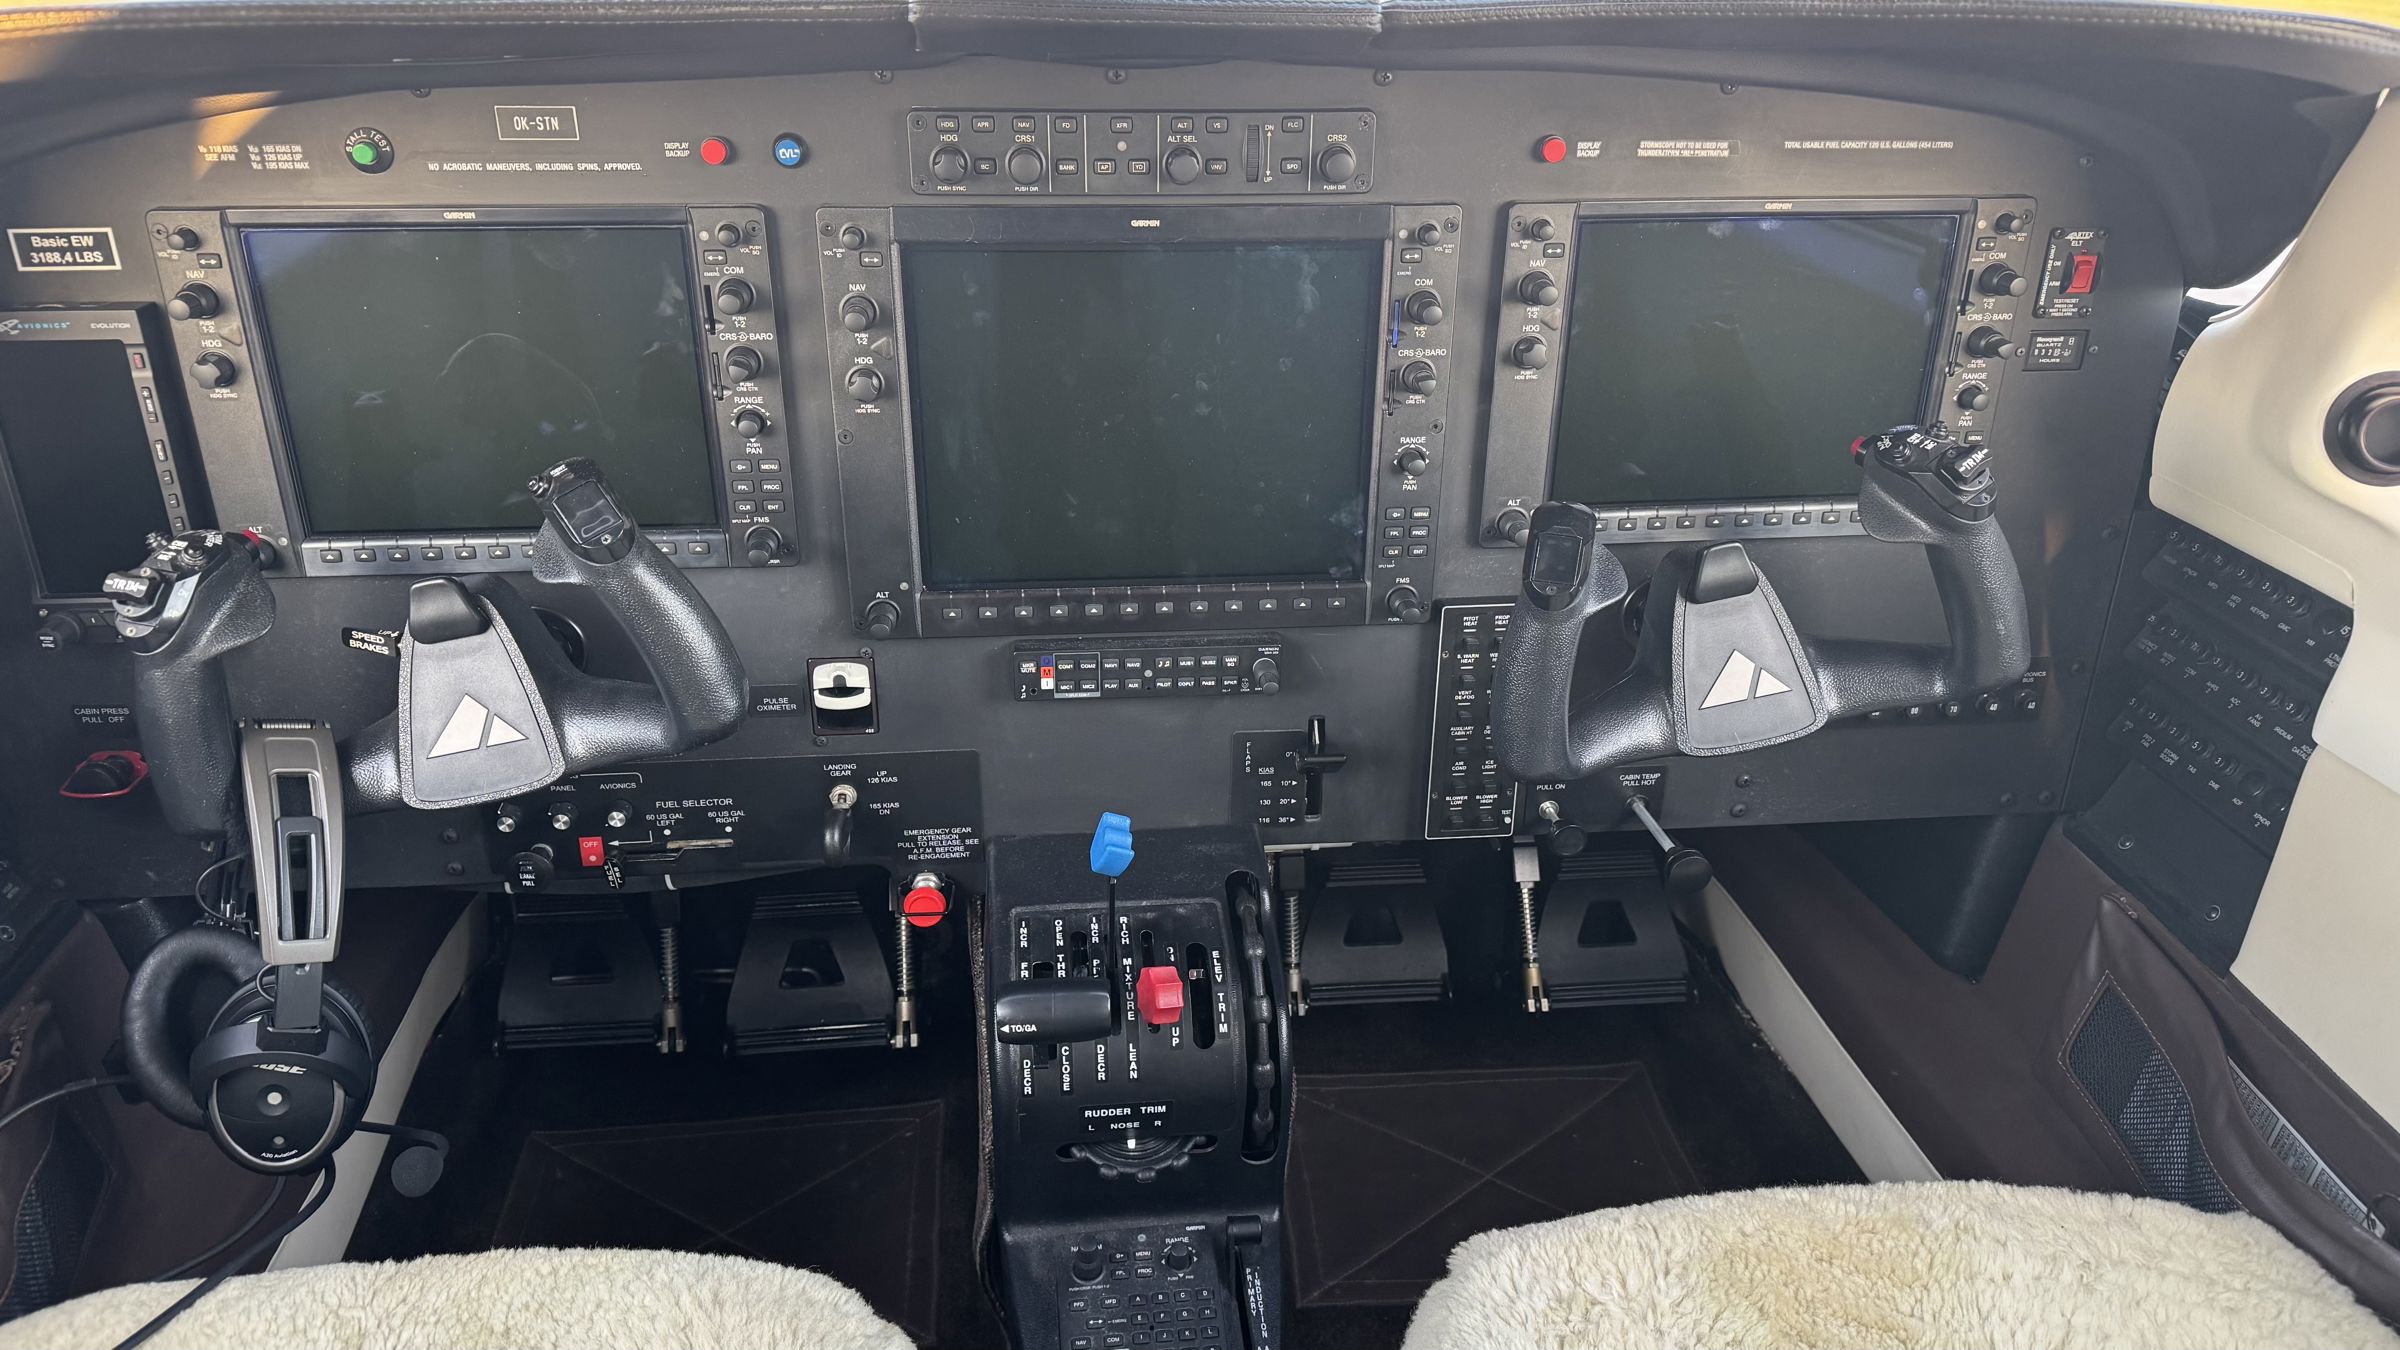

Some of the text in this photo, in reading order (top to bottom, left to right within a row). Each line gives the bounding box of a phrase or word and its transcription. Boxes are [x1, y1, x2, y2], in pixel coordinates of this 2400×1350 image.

[513, 116, 560, 131] OK-STN
[345, 128, 391, 153] STALL TEST
[940, 134, 958, 142] HDG
[1015, 134, 1035, 142] CRS1
[1167, 135, 1198, 143] ALT SEL
[1327, 134, 1348, 142] CRS2
[664, 142, 689, 150] DISPLAY
[1802, 141, 1824, 149] USABLE
[1825, 141, 1840, 149] FUEL
[1841, 141, 1868, 149] CAPACITY
[665, 150, 690, 158] BACKUP
[428, 163, 643, 172] NO ACROBATIC MANEUVERS, INCLUDING SPINS, APPROVED.
[1764, 202, 1793, 210] GARMIN
[1131, 219, 1160, 227] GARMIN
[31, 236, 94, 247] Basic EW
[30, 252, 104, 264] 3188,4 LBS
[1989, 252, 2006, 260] COM
[186, 270, 205, 278] NAV
[723, 267, 744, 275] COM
[201, 339, 222, 348] HDG
[1398, 349, 1414, 357] CRS
[351, 630, 385, 645] SPEED
[349, 639, 389, 655] BRAKES
[823, 763, 857, 771] LANDING
[599, 782, 637, 790] AVIONICS
[656, 798, 733, 809] FUEL SELECTOR
[668, 812, 684, 820] GAL
[718, 810, 729, 818] US
[656, 819, 675, 827] LEFT
[715, 816, 740, 824] RIGHT
[903, 828, 950, 836] EMERGENCY
[917, 833, 959, 841] EXTENSION
[583, 840, 599, 848] OFF
[908, 852, 970, 860] RE-ENGAGEMENT
[604, 865, 616, 888] FUEL
[1019, 920, 1028, 948] INCR
[1054, 919, 1064, 947] OPEN
[1090, 916, 1100, 944] INCR
[1119, 916, 1130, 945] RICH
[1122, 957, 1136, 1021] MIXTURE
[1211, 950, 1228, 1034] ELEV TRIM
[1010, 1024, 1037, 1033] TO/GA
[1171, 1026, 1180, 1047] UP
[1096, 1044, 1106, 1081] DECR
[1129, 1043, 1138, 1080] LEAN
[1061, 1046, 1071, 1092] CLOSE
[1023, 1059, 1032, 1096] DECR
[1084, 1105, 1167, 1118] RUDDER TRIM
[1110, 1121, 1141, 1130] NOSE
[1154, 1119, 1162, 1127] R
[1246, 1268, 1268, 1339] PRIMARY INDUCTION
